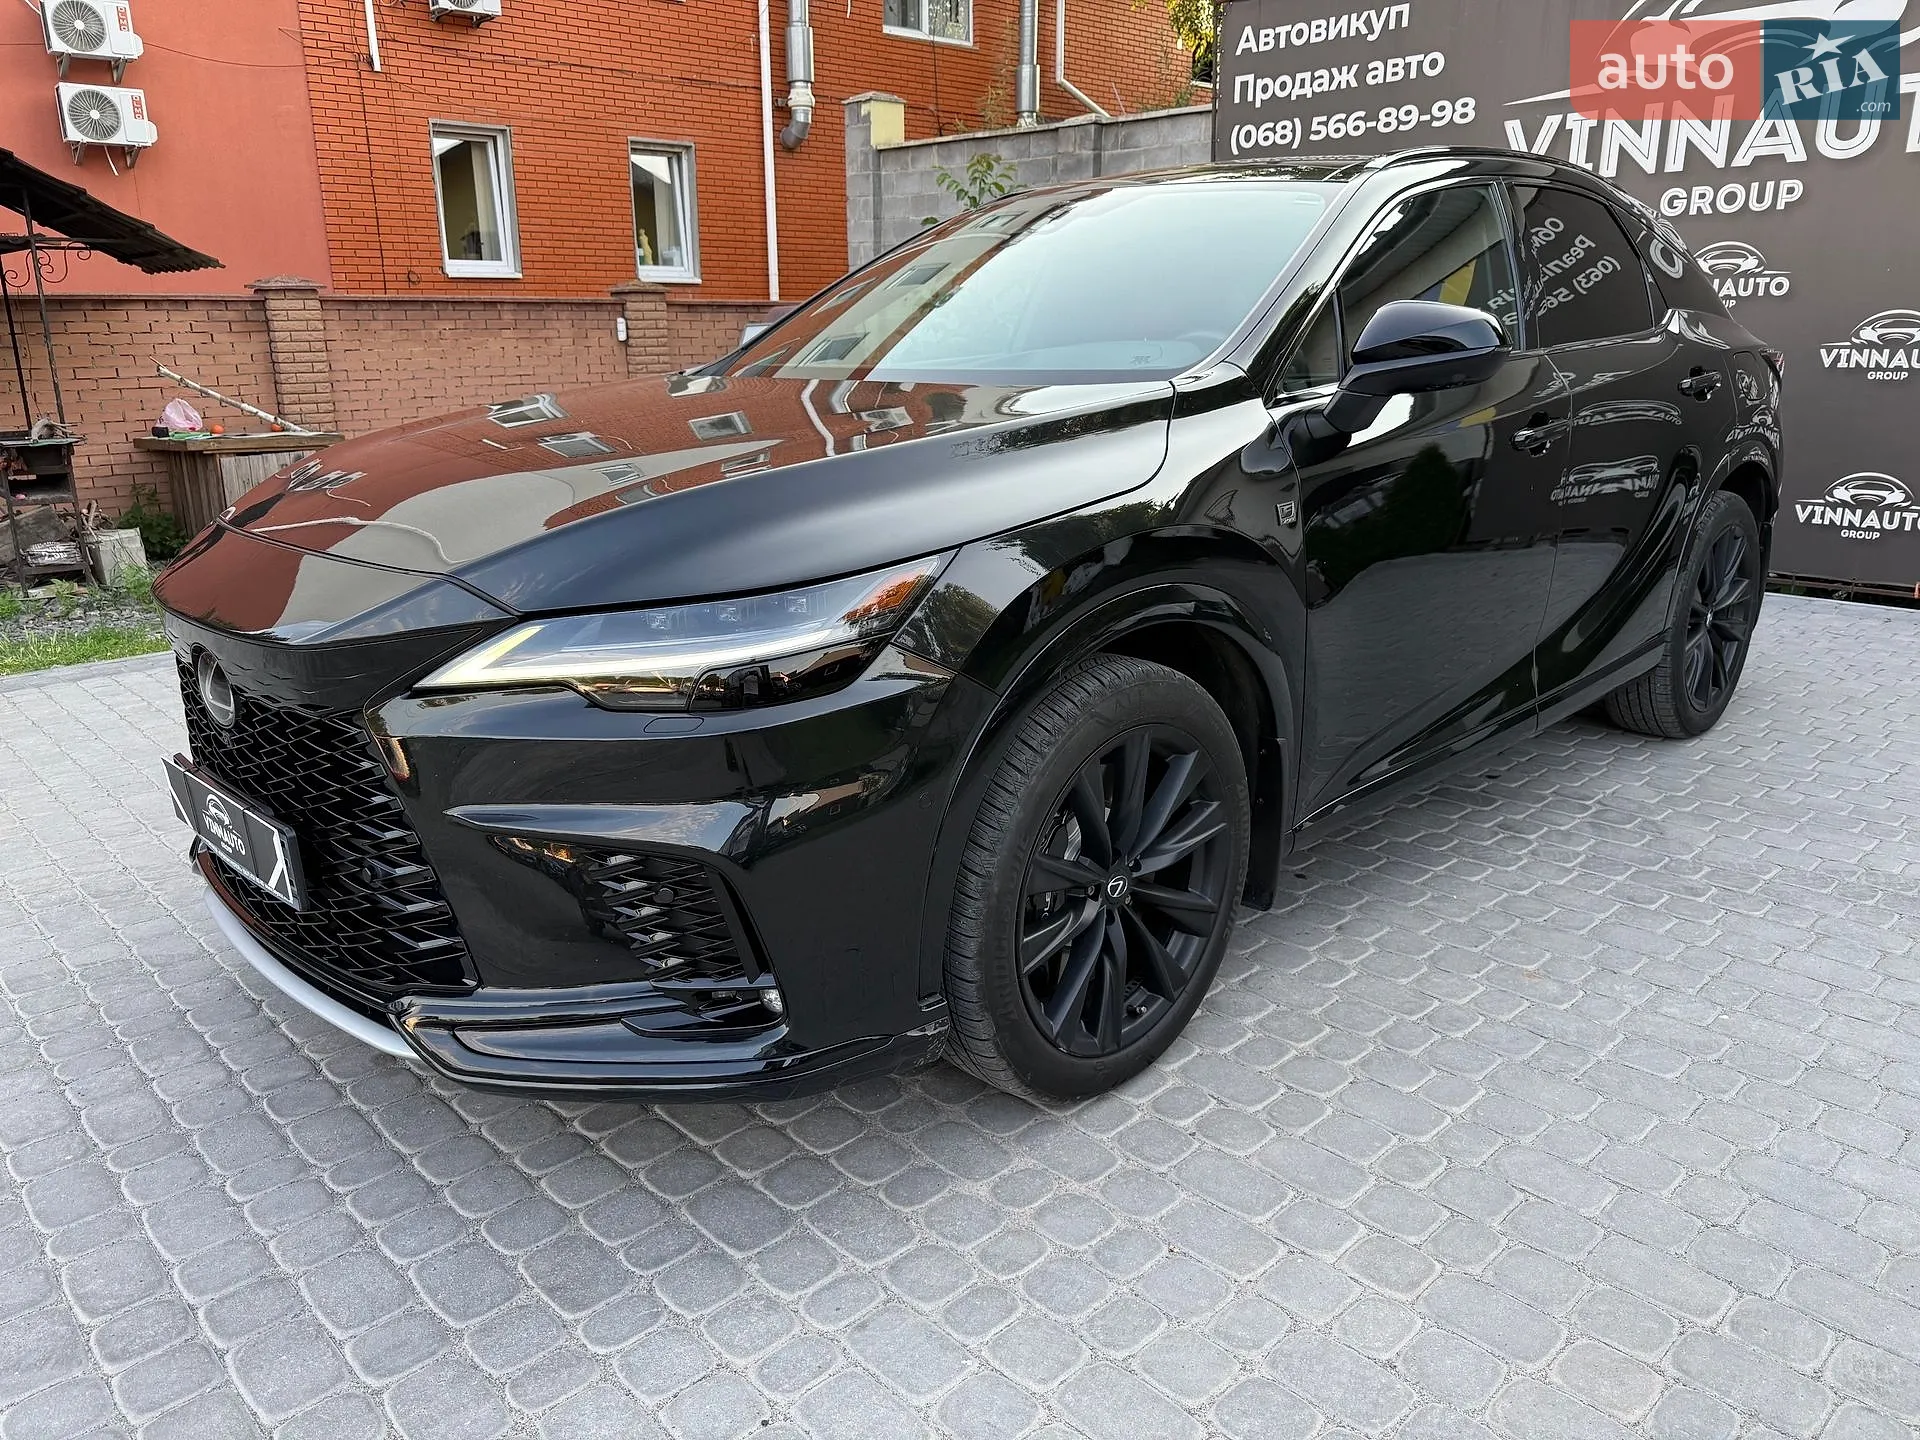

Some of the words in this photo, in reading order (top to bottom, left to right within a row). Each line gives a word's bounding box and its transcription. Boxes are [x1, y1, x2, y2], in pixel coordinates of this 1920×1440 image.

[1235, 3, 1411, 55] Автовикуп
[1233, 63, 1360, 108] Продаж
[1366, 51, 1446, 86] авто
[1230, 118, 1302, 155] (068)
[1309, 97, 1476, 141] 566-89-98
[1659, 178, 1804, 217] GROUP
[1867, 371, 1909, 381] GROUP
[1795, 504, 1920, 531] VINNAUT
[1840, 529, 1880, 540] GROUP
